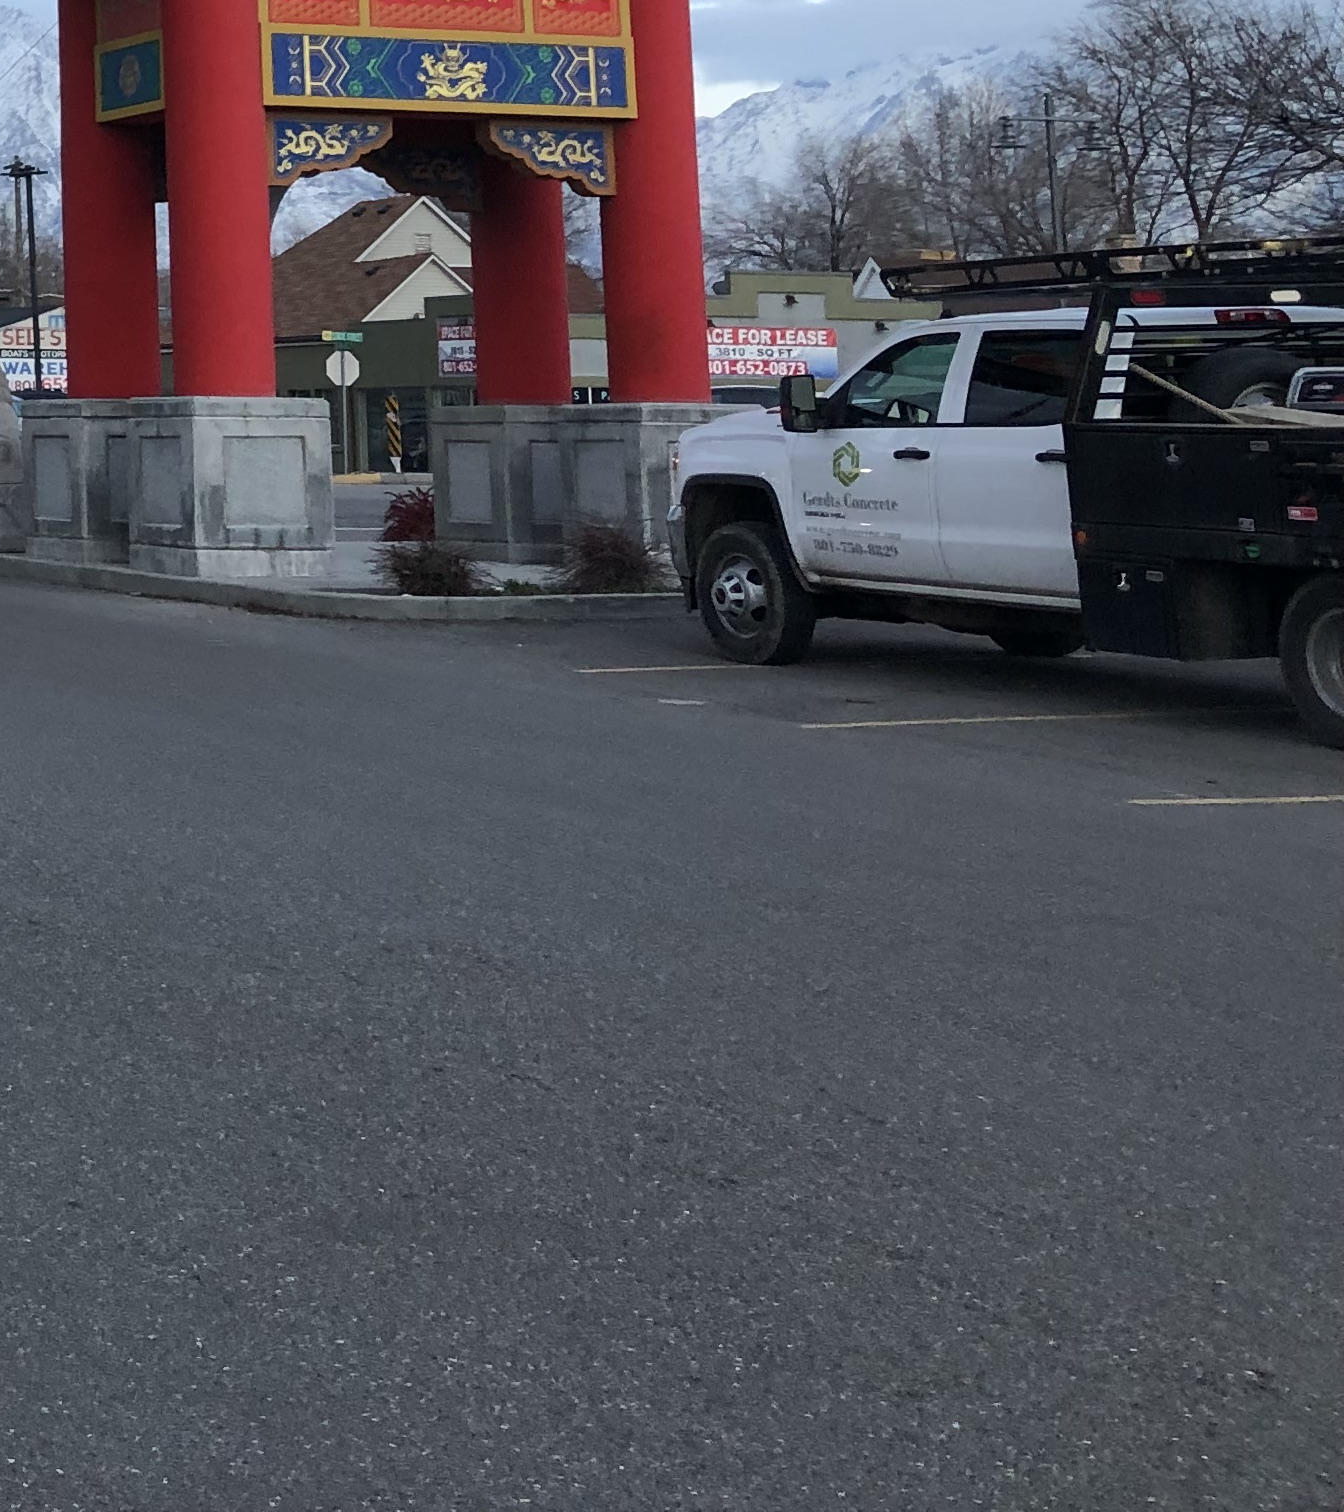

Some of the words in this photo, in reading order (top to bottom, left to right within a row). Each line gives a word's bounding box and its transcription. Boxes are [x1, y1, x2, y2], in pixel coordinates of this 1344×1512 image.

[738, 329, 771, 344] FOR
[776, 330, 827, 345] LEASE
[716, 347, 745, 357] 3810
[757, 348, 774, 357] SQ
[778, 349, 793, 357] FT
[844, 492, 900, 511] Concrete
